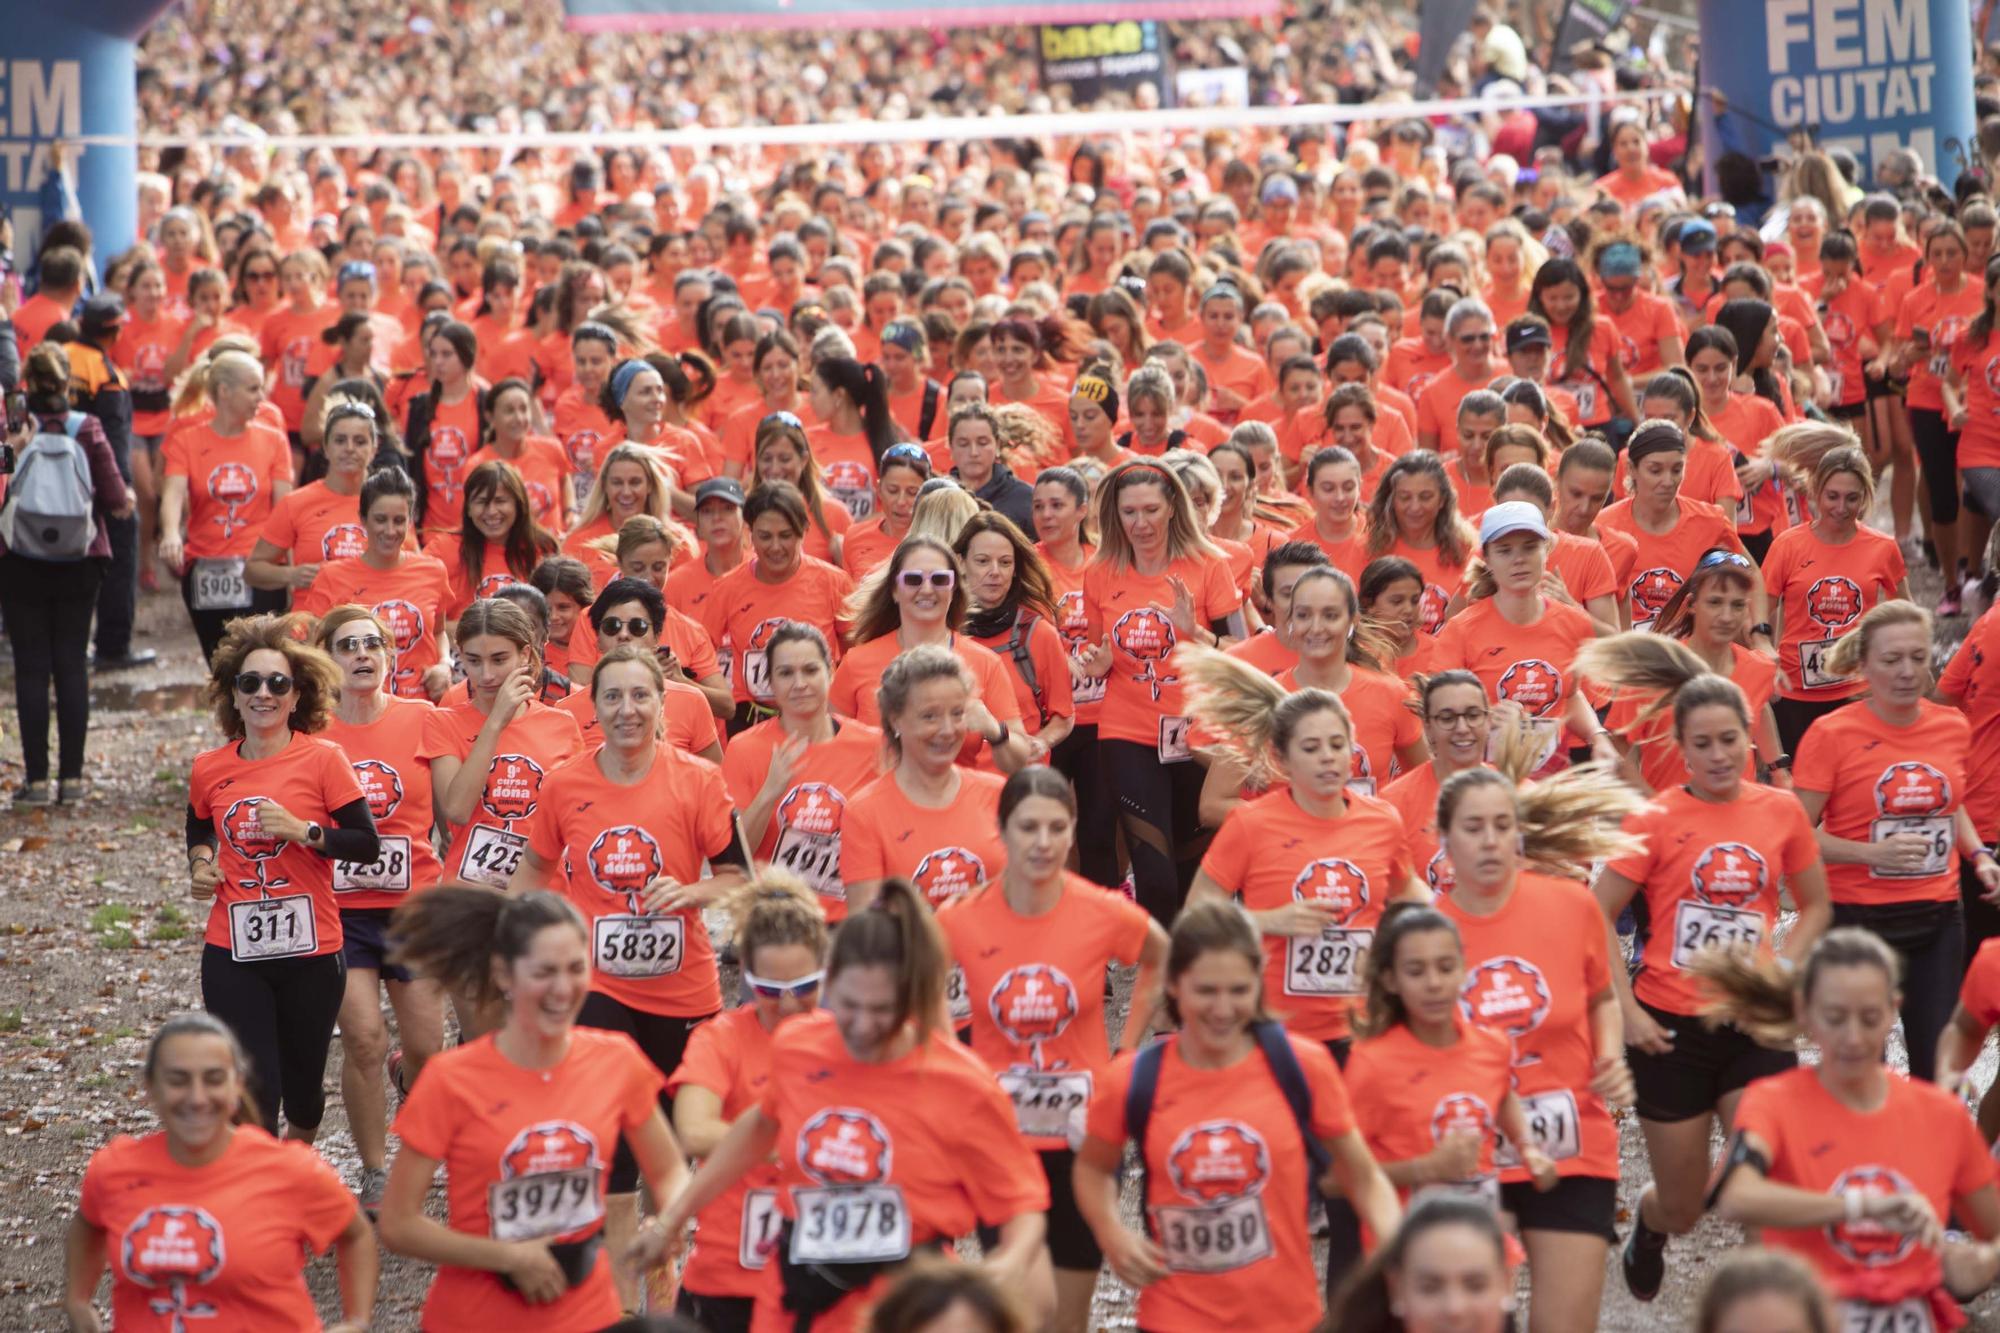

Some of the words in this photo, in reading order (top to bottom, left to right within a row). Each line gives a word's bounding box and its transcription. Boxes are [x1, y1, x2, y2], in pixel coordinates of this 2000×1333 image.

[1765, 0, 1932, 74] FEM
[1770, 63, 1936, 127] CIUTAT
[199, 577, 242, 596] 5905
[492, 786, 530, 799] dona
[497, 778, 528, 786] cursa
[247, 911, 296, 942] 311
[602, 933, 676, 961] 5832
[501, 1177, 589, 1222] 3979
[806, 1201, 897, 1240] 3978
[1170, 1213, 1257, 1254] 3980
